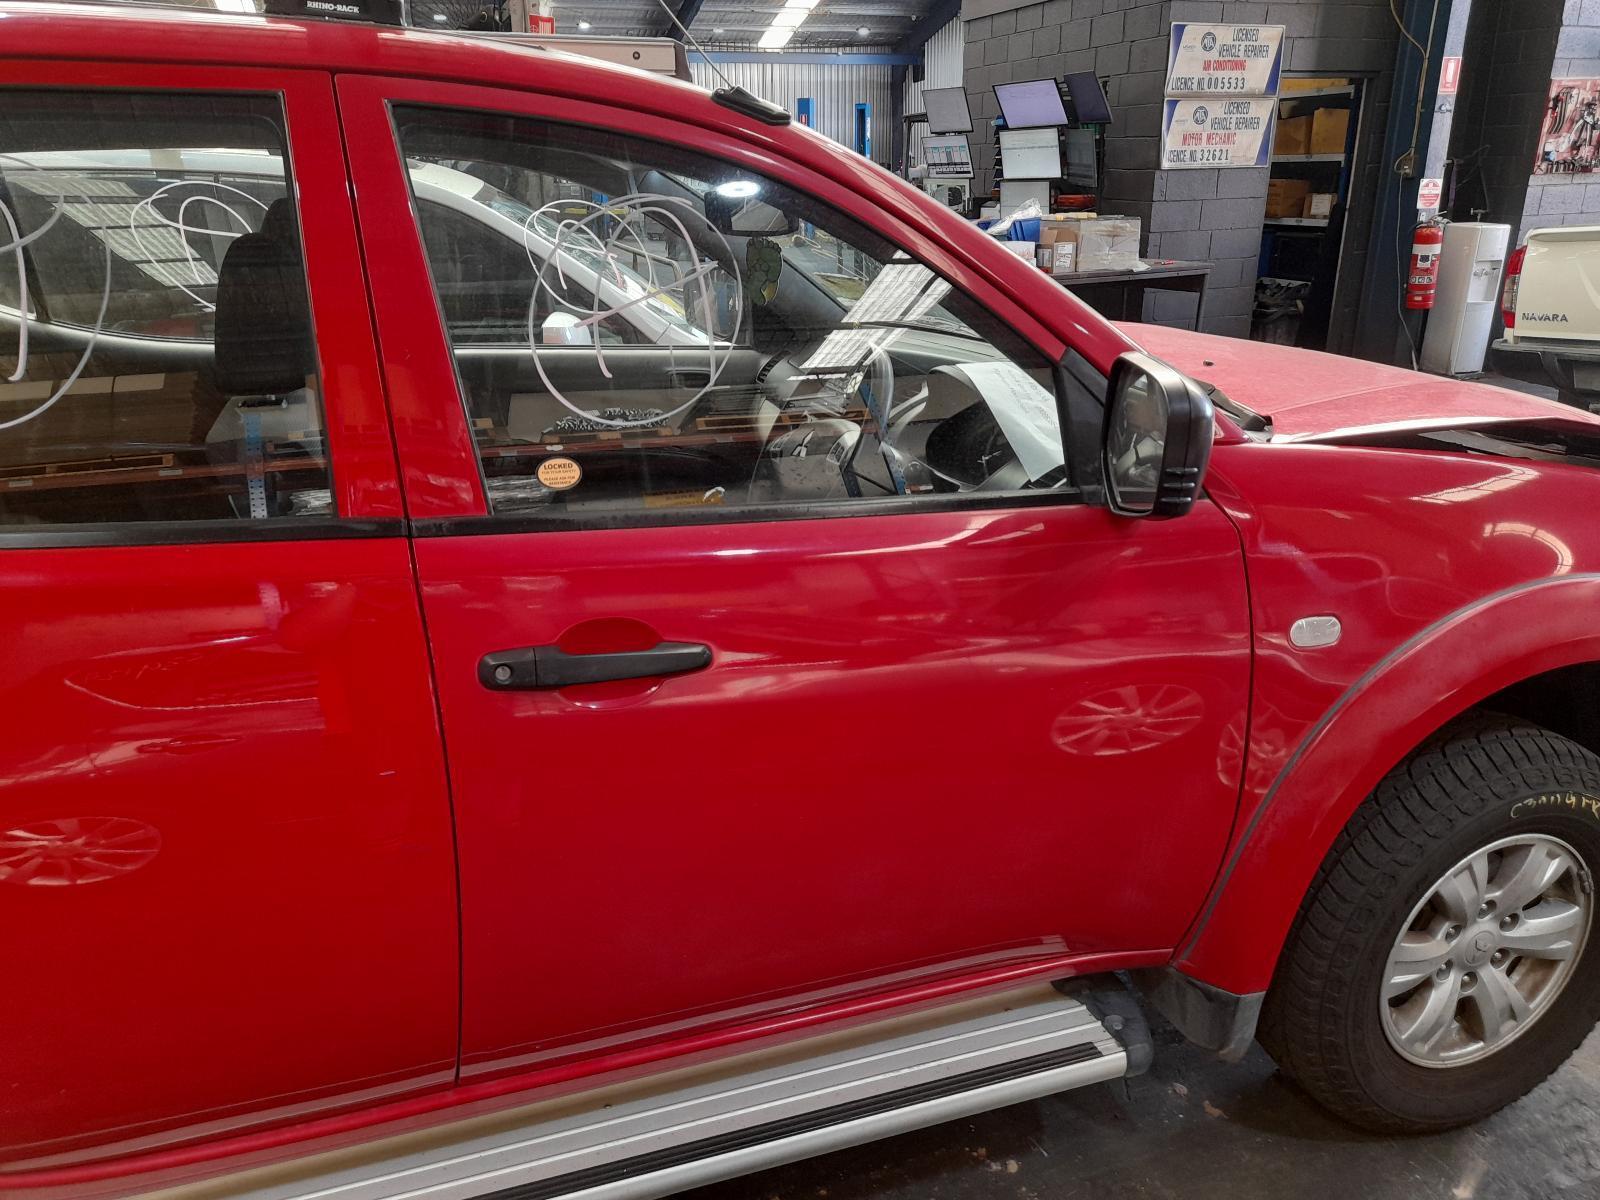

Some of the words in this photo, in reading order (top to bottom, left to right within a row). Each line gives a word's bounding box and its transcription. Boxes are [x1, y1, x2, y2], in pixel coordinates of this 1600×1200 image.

[306, 1, 360, 13] RHINO-RACK
[1233, 28, 1259, 42] LICENSED
[1219, 44, 1241, 58] VEHICLE
[1243, 45, 1270, 58] REPAIRER
[1203, 60, 1212, 71] AIR
[1212, 60, 1247, 71] CONDITIONING
[1171, 76, 1194, 91] LICENCE
[1207, 77, 1246, 90] 005533
[1224, 101, 1251, 115] LICENSED
[1210, 116, 1233, 130] VEHICLE
[1234, 117, 1261, 130] REPAIRER
[1182, 132, 1203, 146] MOTOR
[1205, 132, 1237, 146] MECHANIC
[1199, 148, 1230, 162] 32621
[1521, 312, 1568, 322] NAVARA
